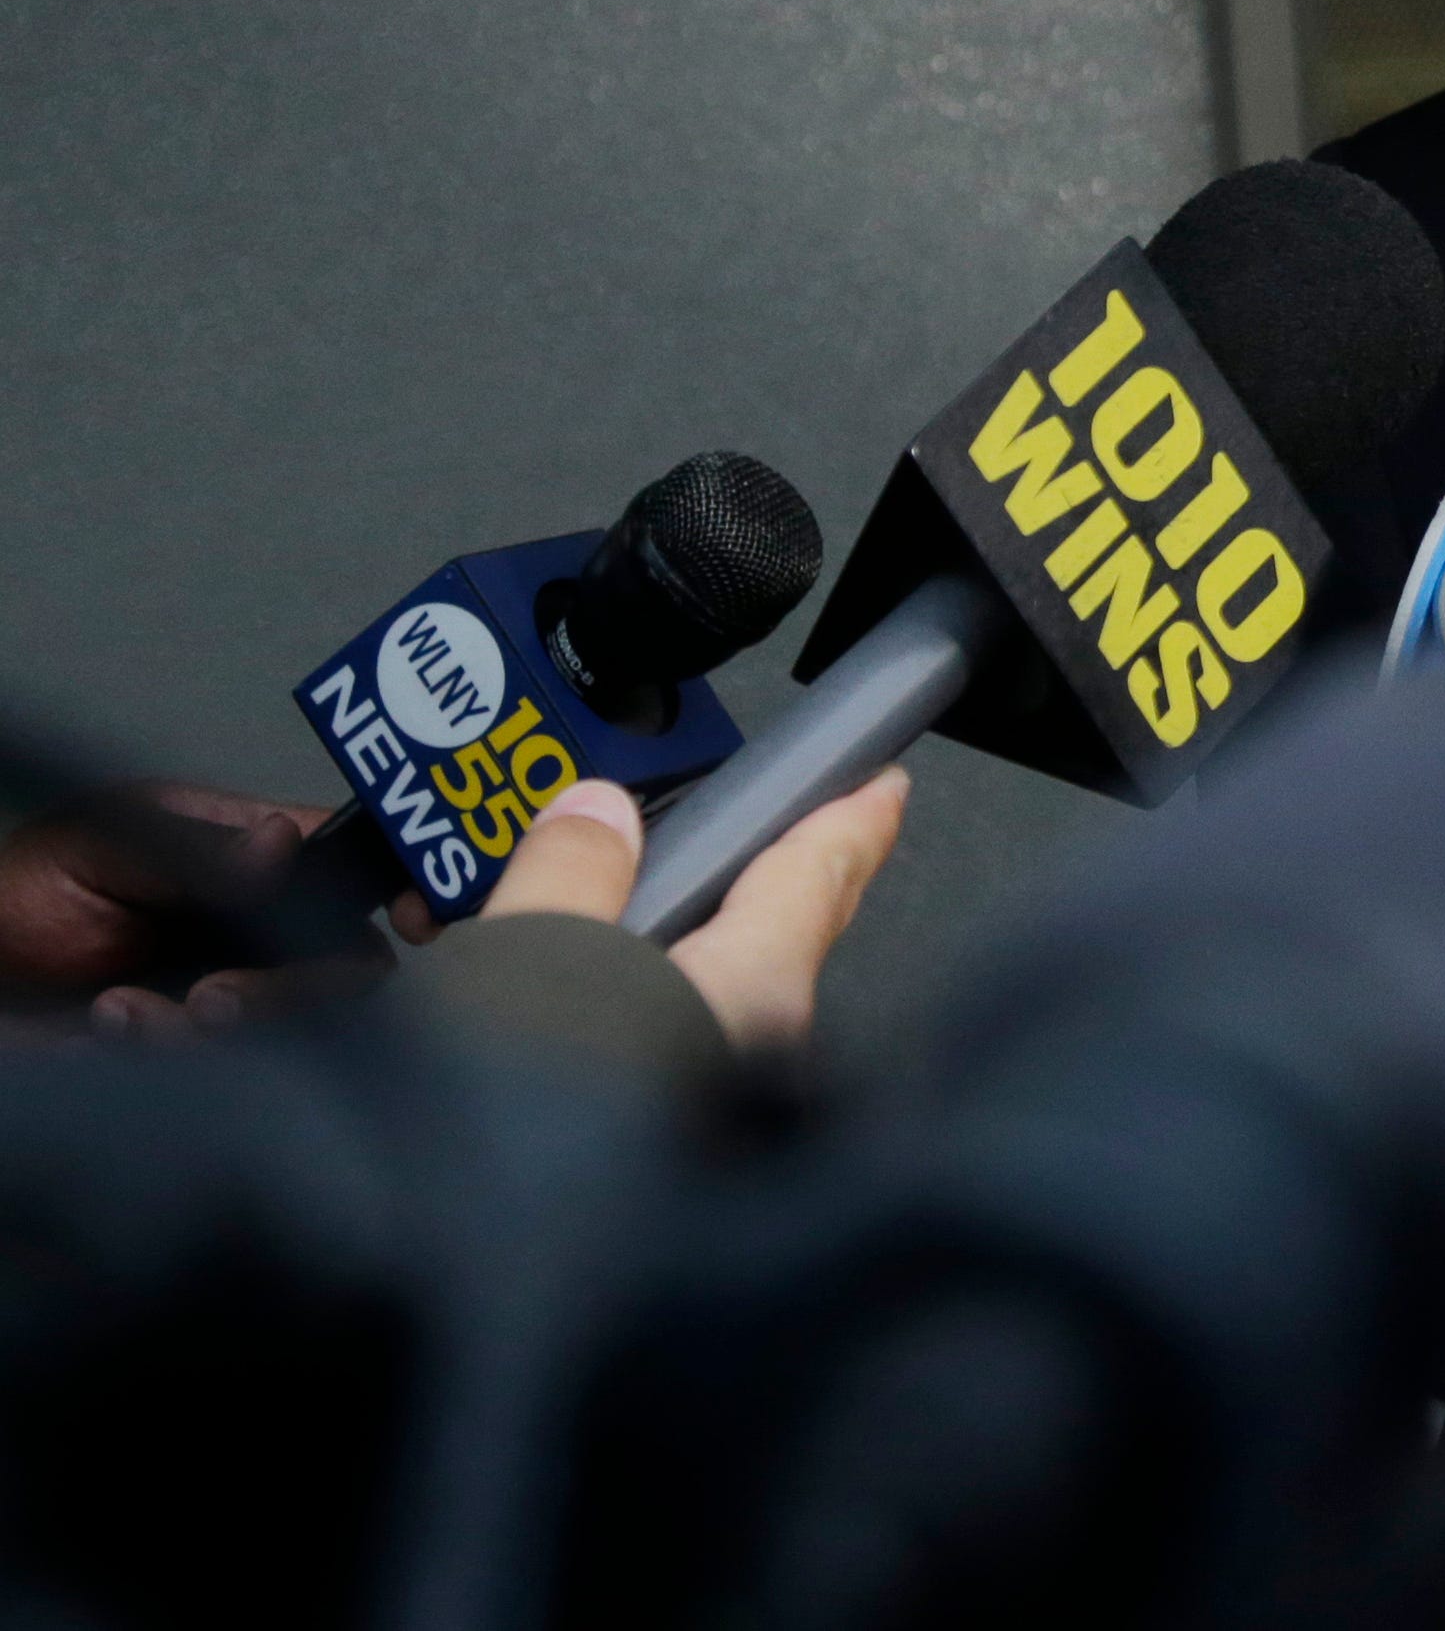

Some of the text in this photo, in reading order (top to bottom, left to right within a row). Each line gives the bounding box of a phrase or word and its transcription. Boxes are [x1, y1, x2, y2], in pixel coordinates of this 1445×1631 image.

[968, 369, 1231, 748] WINS
[1048, 289, 1305, 663] 1010
[397, 611, 490, 731] WLNY
[486, 696, 580, 810] 10
[310, 664, 478, 901] NEWS
[429, 739, 534, 859] 55
